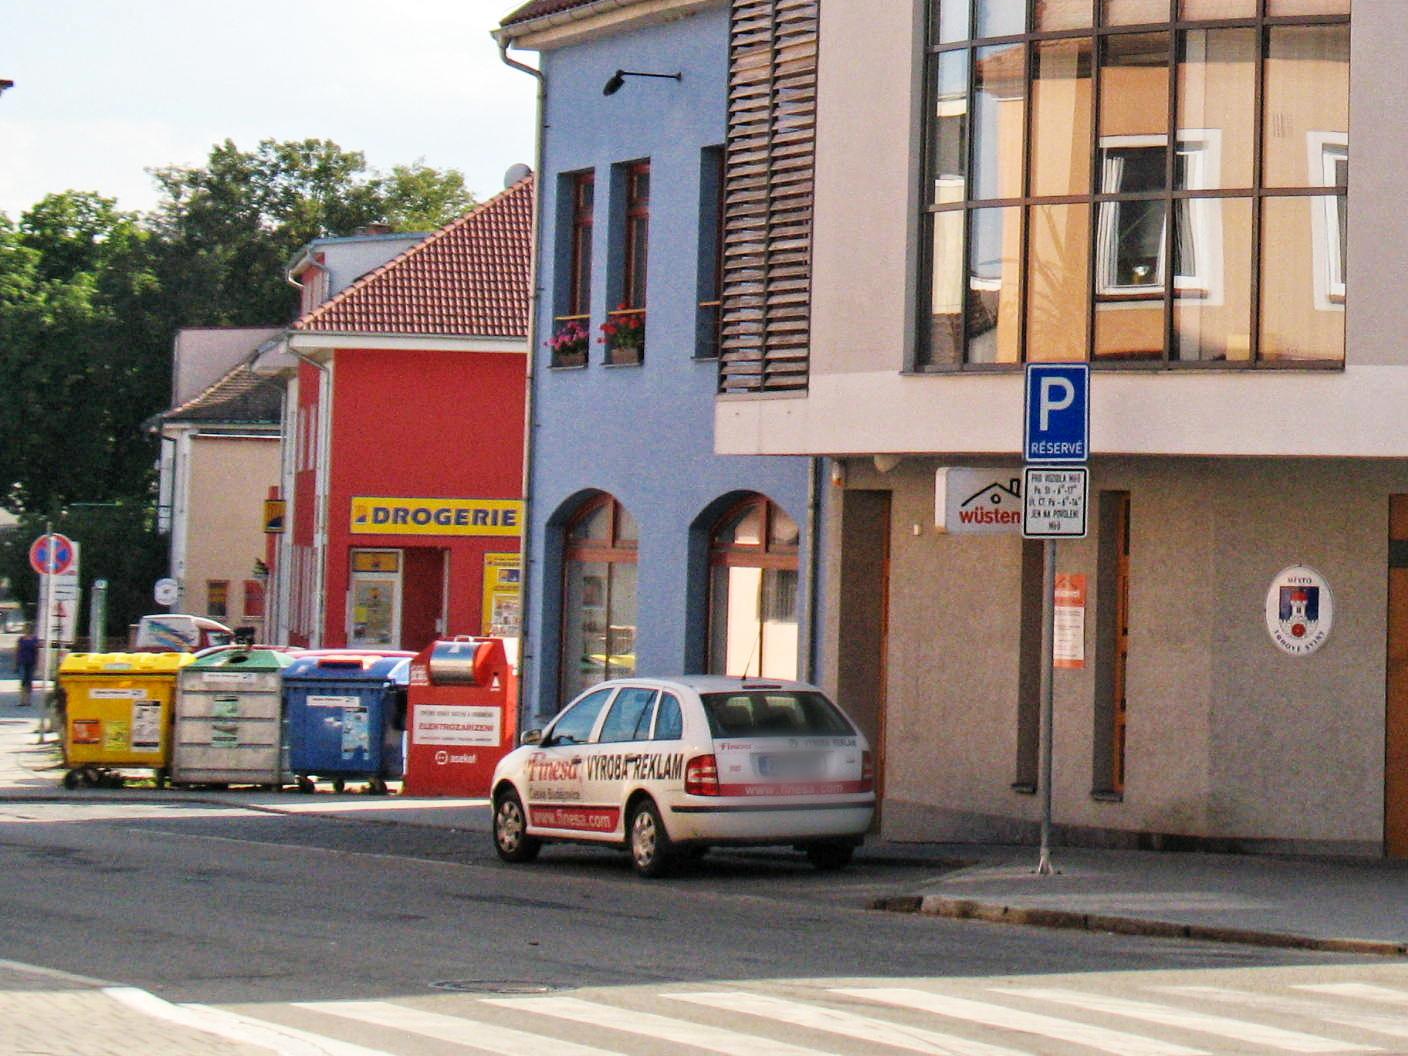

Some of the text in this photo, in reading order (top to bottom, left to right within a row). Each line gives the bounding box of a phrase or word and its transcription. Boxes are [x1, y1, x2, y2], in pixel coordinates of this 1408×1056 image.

[1040, 376, 1075, 431] P
[1031, 440, 1084, 454] RÉSERVÉ
[372, 506, 517, 527] DROGERIE
[632, 752, 684, 780] REKLAM
